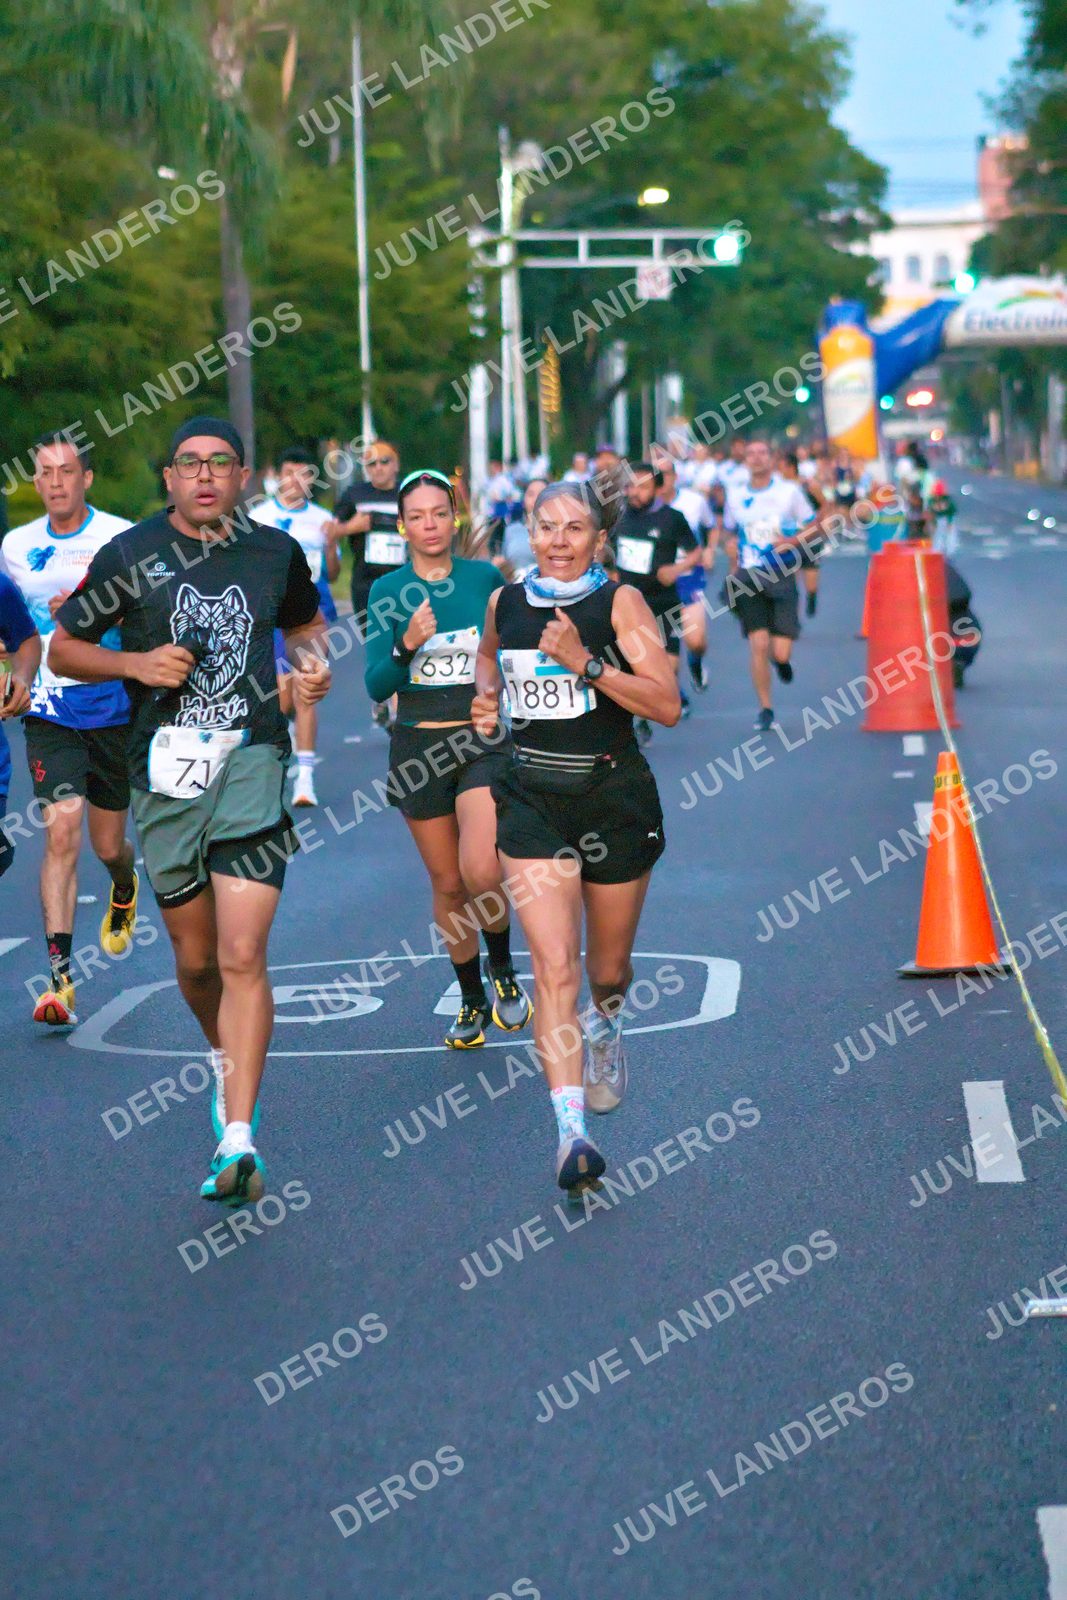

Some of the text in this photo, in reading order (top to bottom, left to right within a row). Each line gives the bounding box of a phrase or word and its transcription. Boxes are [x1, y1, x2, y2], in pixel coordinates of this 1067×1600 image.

[420, 652, 471, 678] 632
[180, 695, 203, 710] LA
[509, 679, 574, 709] 1881
[175, 757, 211, 789] 71
